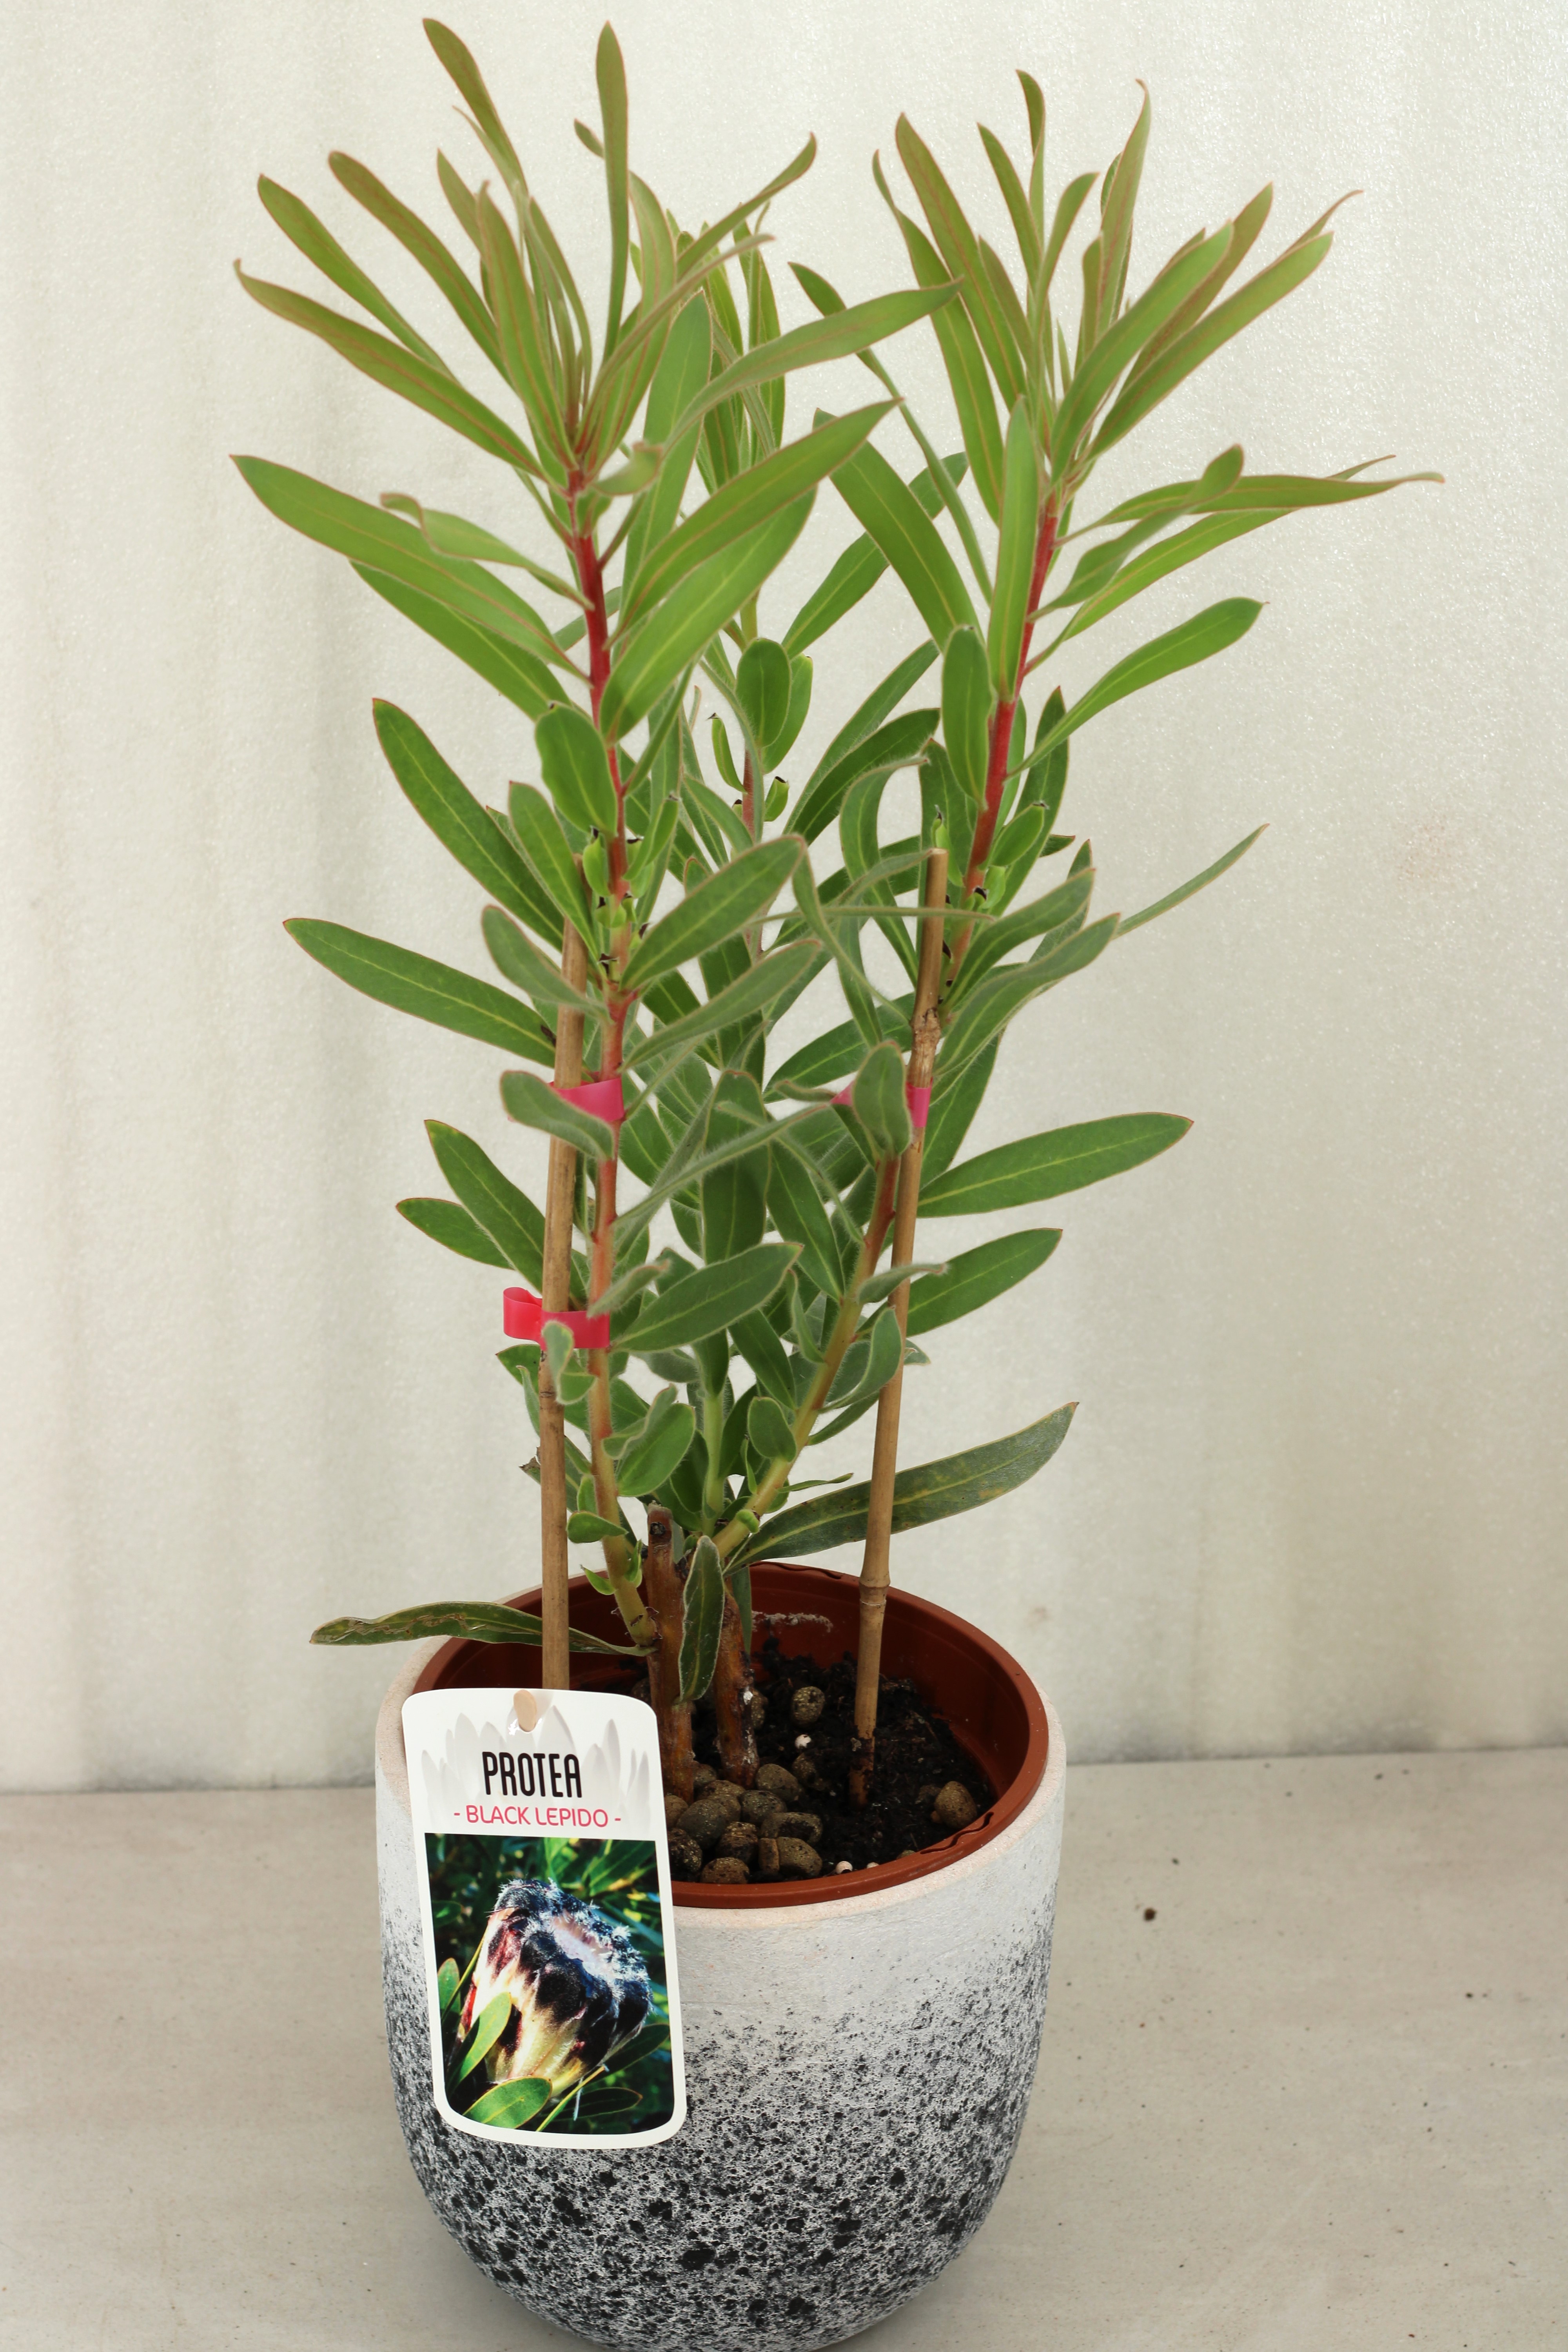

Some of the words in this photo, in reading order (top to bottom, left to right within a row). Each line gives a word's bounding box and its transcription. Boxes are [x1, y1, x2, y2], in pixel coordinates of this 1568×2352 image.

[482, 1751, 582, 1798] PROTEA
[466, 1805, 531, 1825] BLACK
[535, 1808, 608, 1828] LEPIDO
